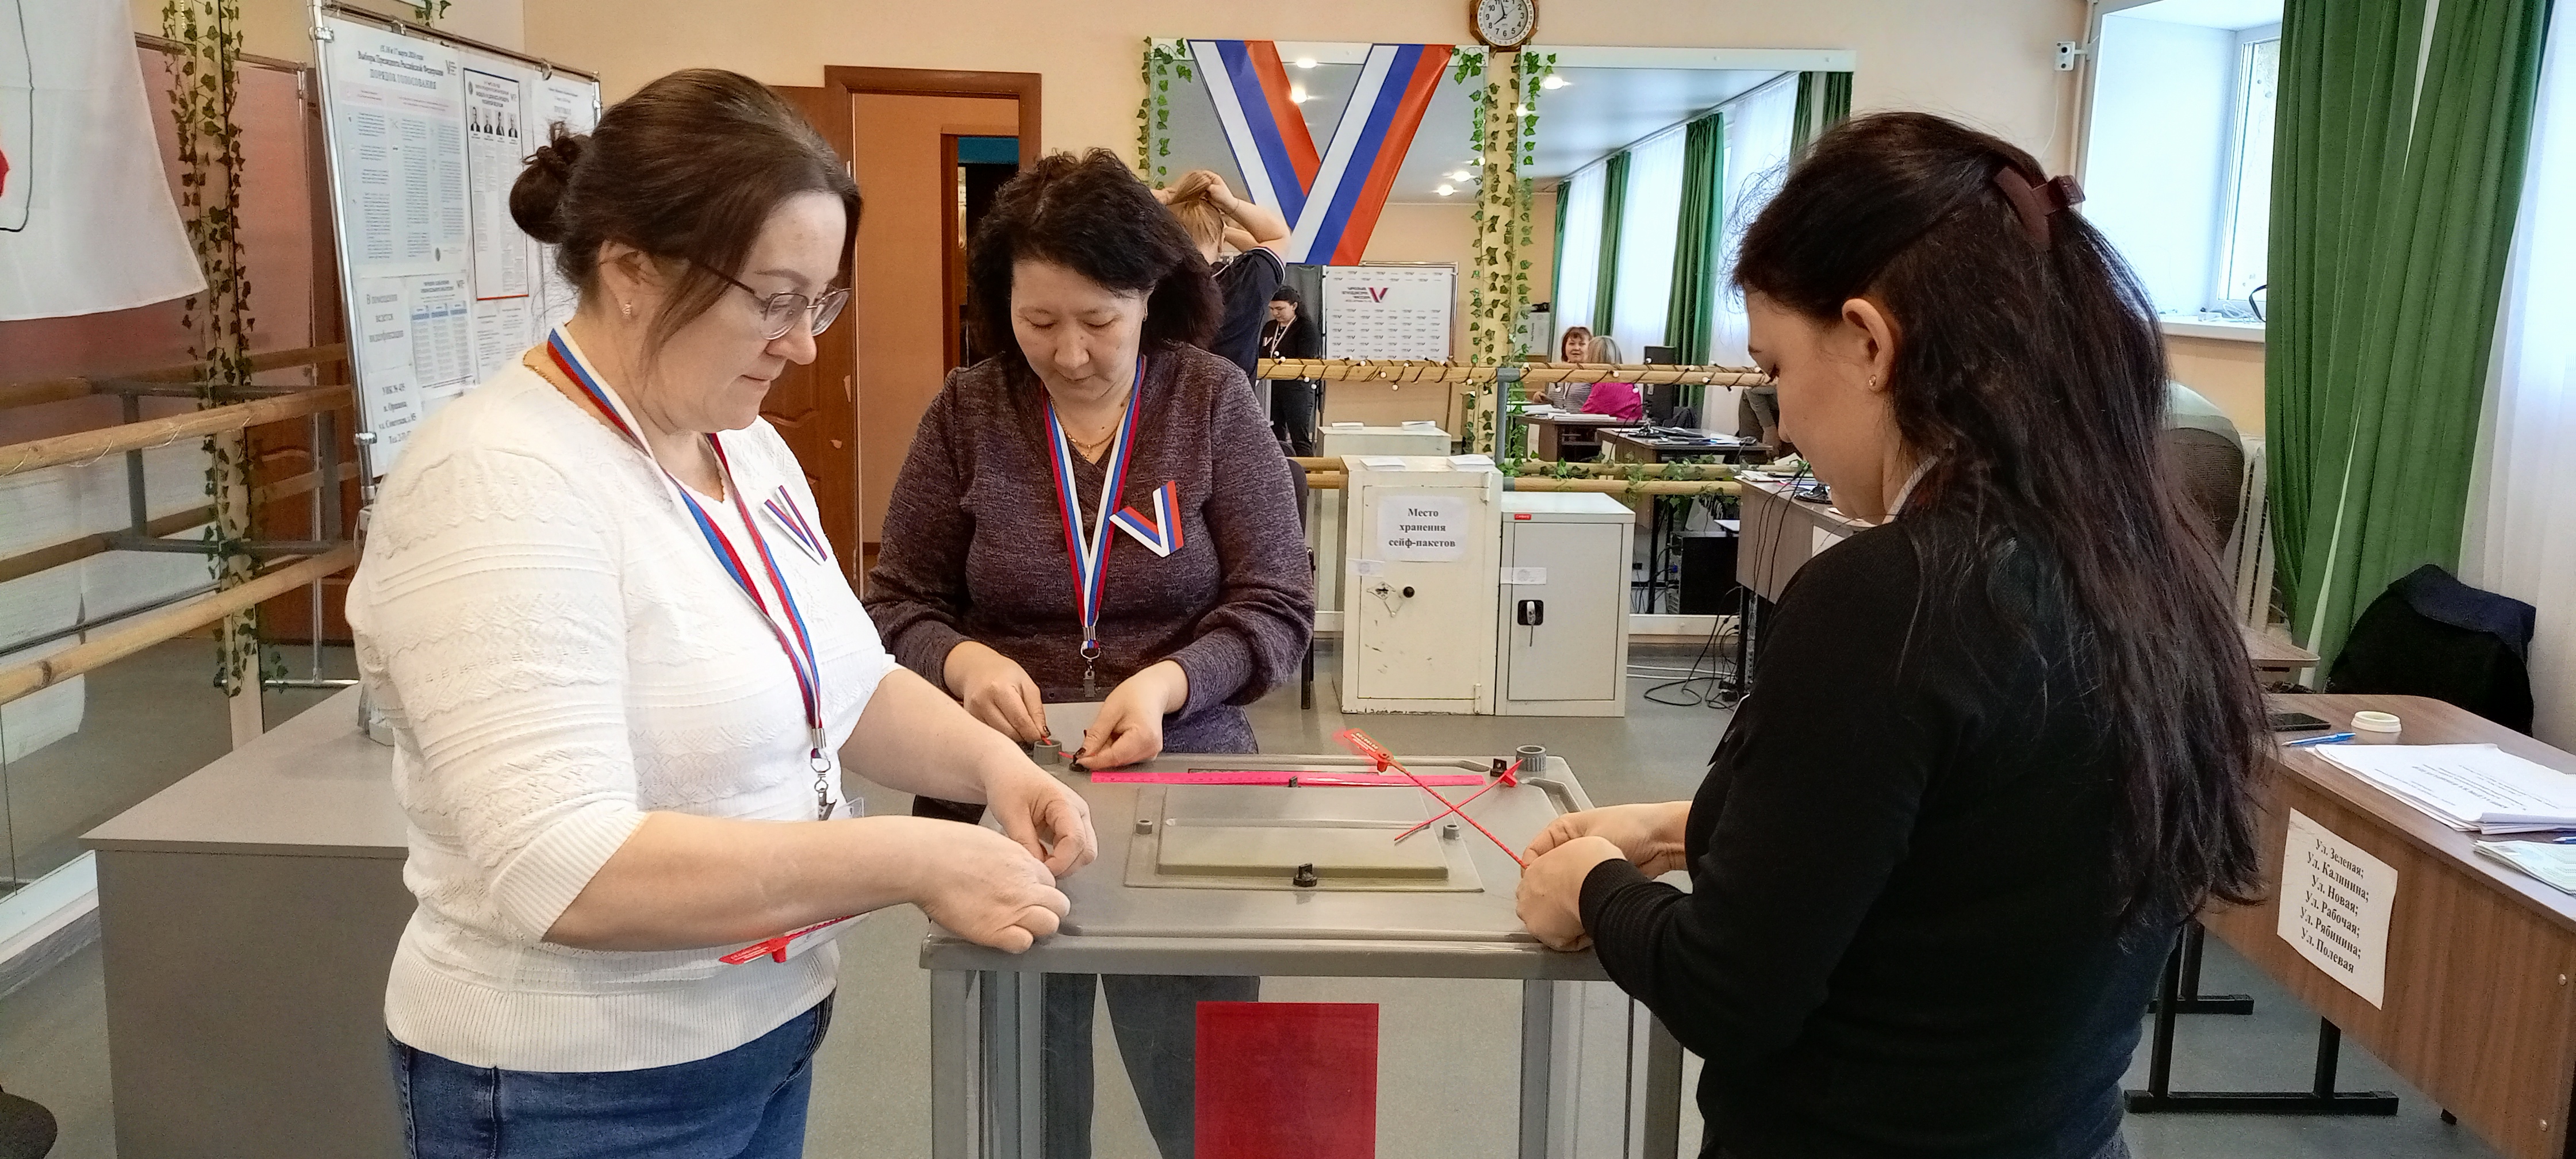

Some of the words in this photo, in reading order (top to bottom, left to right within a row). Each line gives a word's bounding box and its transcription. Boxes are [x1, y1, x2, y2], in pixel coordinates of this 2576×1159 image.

[1399, 524, 1446, 533] хранения
[1408, 508, 1439, 517] Место
[1389, 538, 1456, 548] сейф-пакетов
[2307, 851, 2320, 870] Ул.
[2322, 862, 2369, 903] Калинина;
[2316, 839, 2328, 855] Ул.
[2330, 847, 2363, 879] Зеленая;
[2306, 891, 2319, 909] Ул.
[2321, 901, 2360, 938] Рабочая;
[2312, 875, 2325, 894] Ул.
[2328, 885, 2358, 916] Новая;
[2300, 907, 2313, 926] Ул.
[2301, 927, 2314, 946] Ул.
[2316, 938, 2354, 973] Полевая
